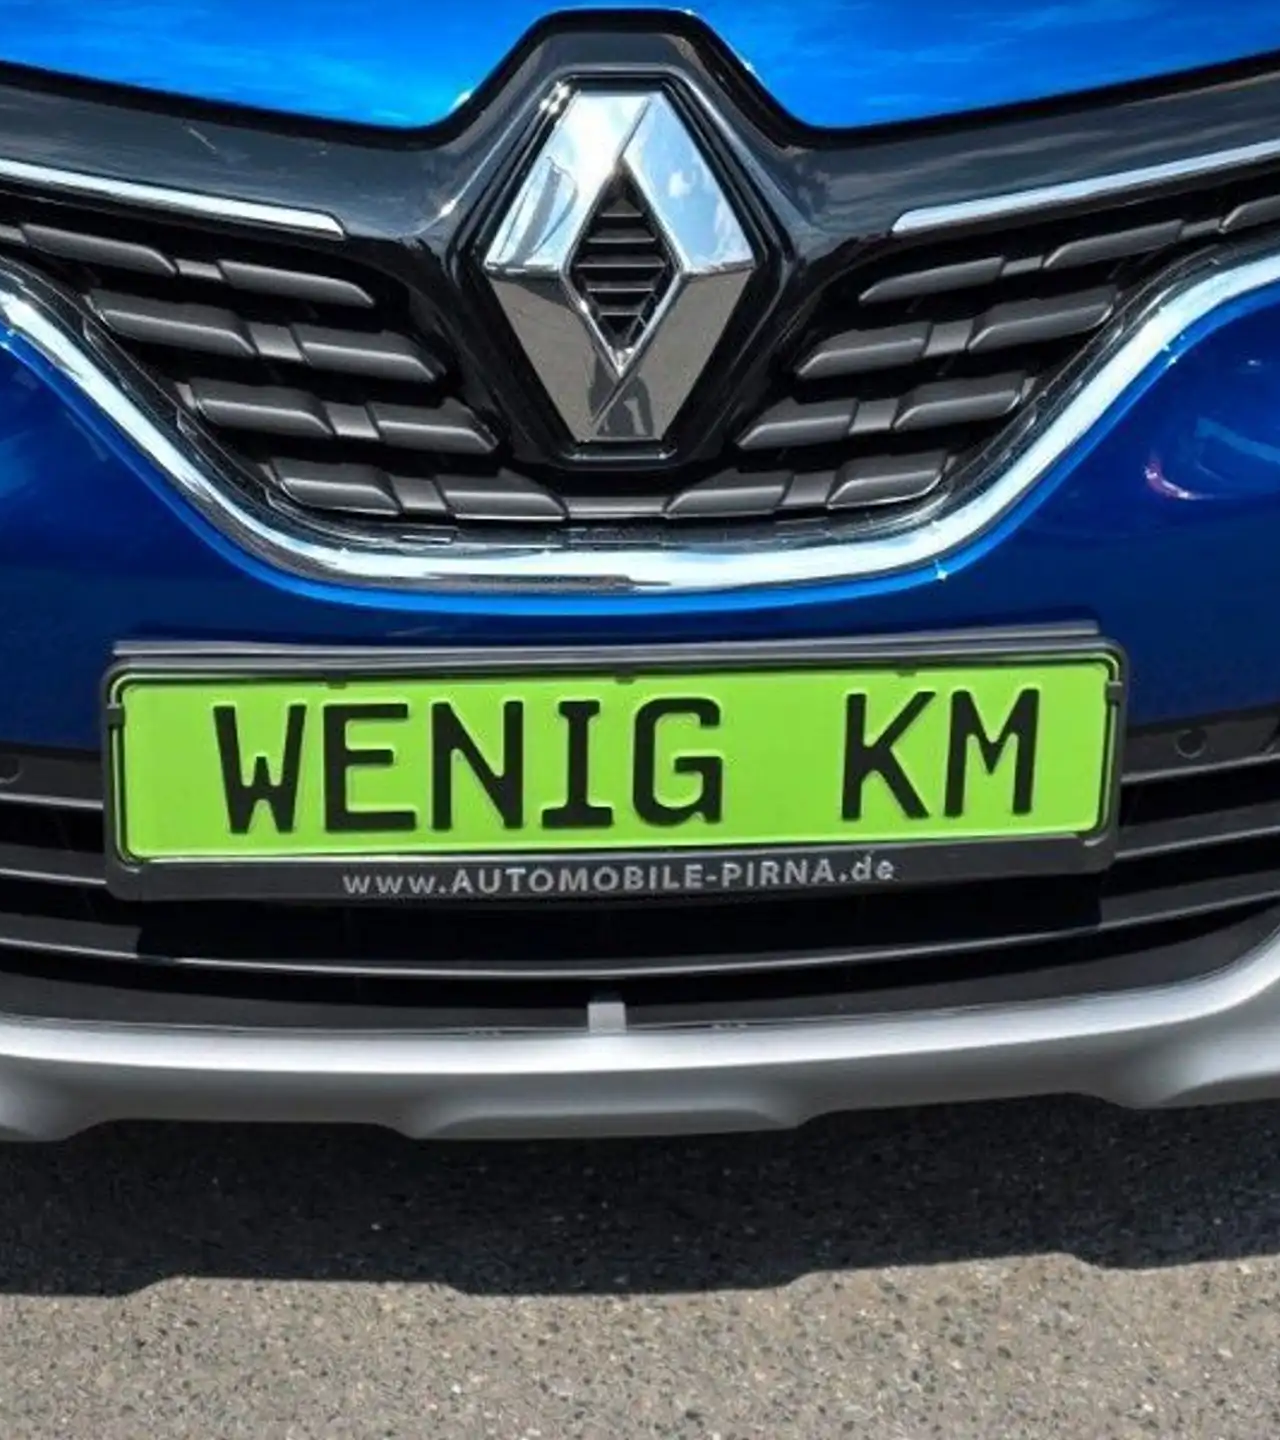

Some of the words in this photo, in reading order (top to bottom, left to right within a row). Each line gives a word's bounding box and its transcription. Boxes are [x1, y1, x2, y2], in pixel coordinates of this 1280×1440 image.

[213, 697, 723, 834] WENIG
[840, 688, 1040, 821] KM
[342, 855, 896, 895] www.AUTOMOBILE-PIRNA.de
